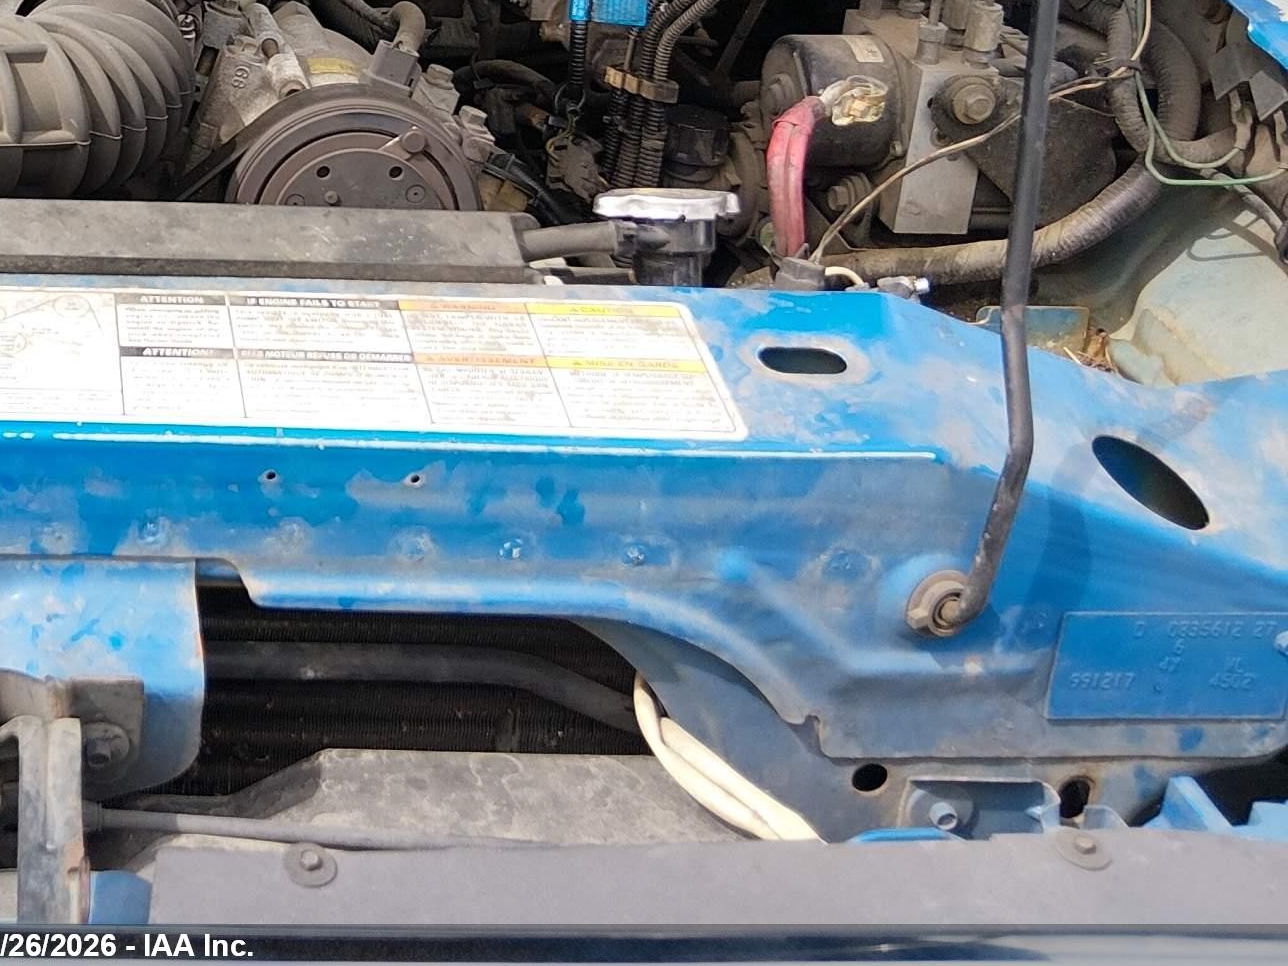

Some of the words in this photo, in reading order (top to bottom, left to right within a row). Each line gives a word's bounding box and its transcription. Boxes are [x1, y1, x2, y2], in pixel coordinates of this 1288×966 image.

[140, 295, 204, 304] ATTENTION
[258, 298, 298, 306] ENGINE
[300, 299, 329, 307] FAILS
[348, 300, 380, 308] START
[265, 350, 305, 359] MOTEUR
[307, 351, 342, 360] REFUSE
